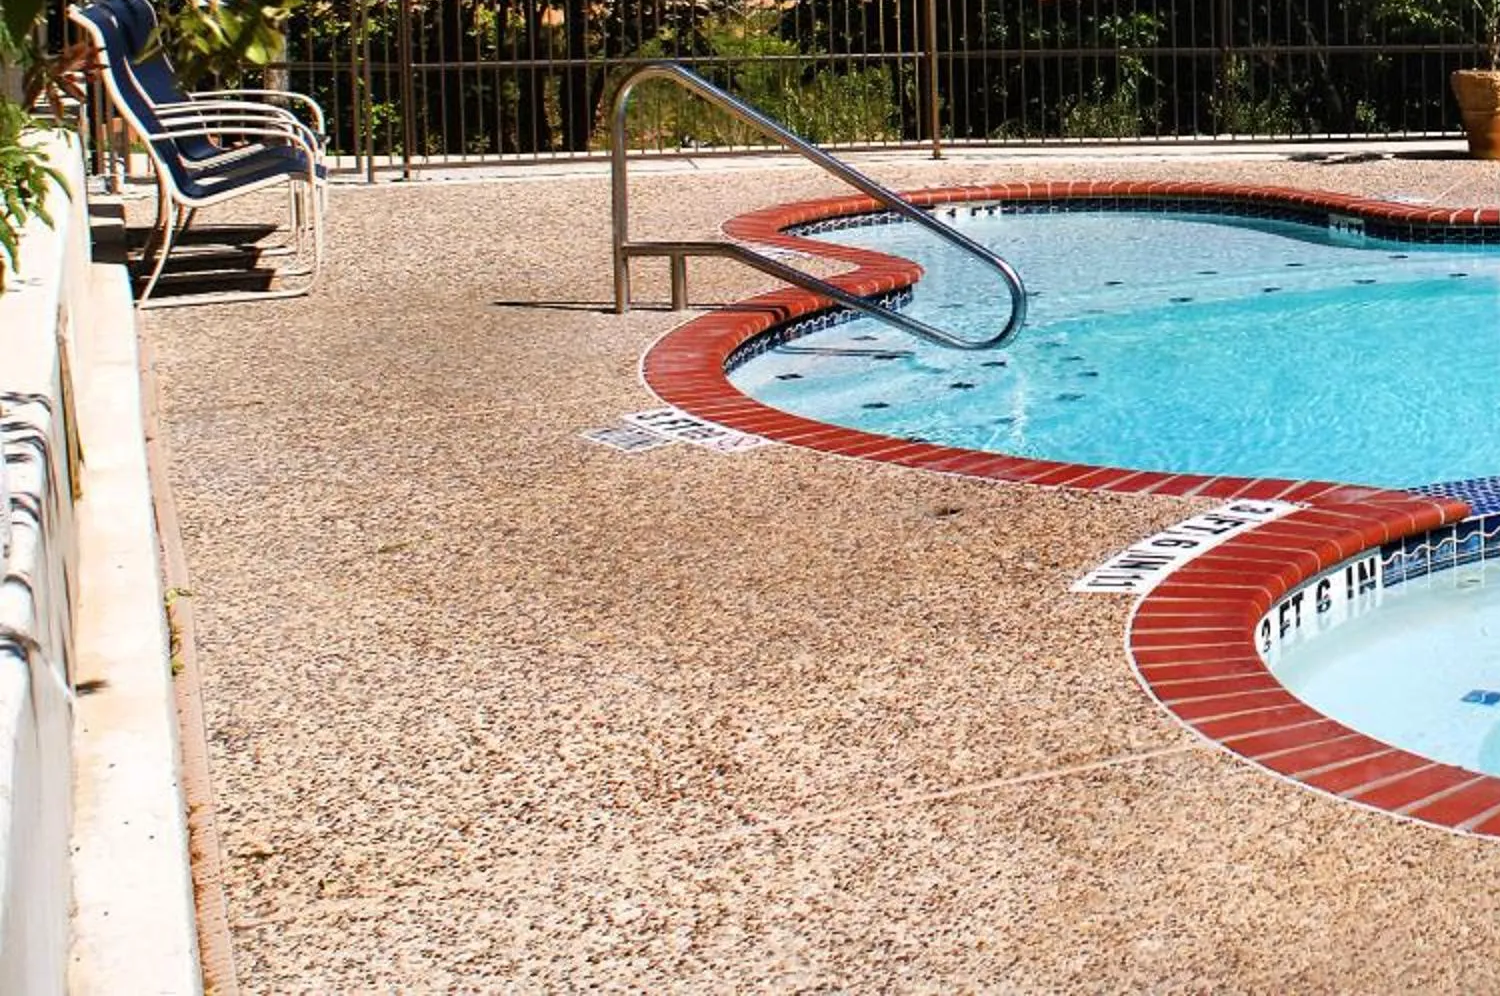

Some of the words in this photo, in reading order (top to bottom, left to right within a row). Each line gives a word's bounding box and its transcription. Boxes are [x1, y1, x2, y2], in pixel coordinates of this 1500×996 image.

[1183, 513, 1246, 536] FT
[1150, 537, 1200, 549] 6
[1109, 553, 1177, 571] IN
[1260, 617, 1272, 653] 3
[1279, 591, 1305, 640] FT
[1316, 577, 1332, 615] 6
[1345, 556, 1377, 601] IN
